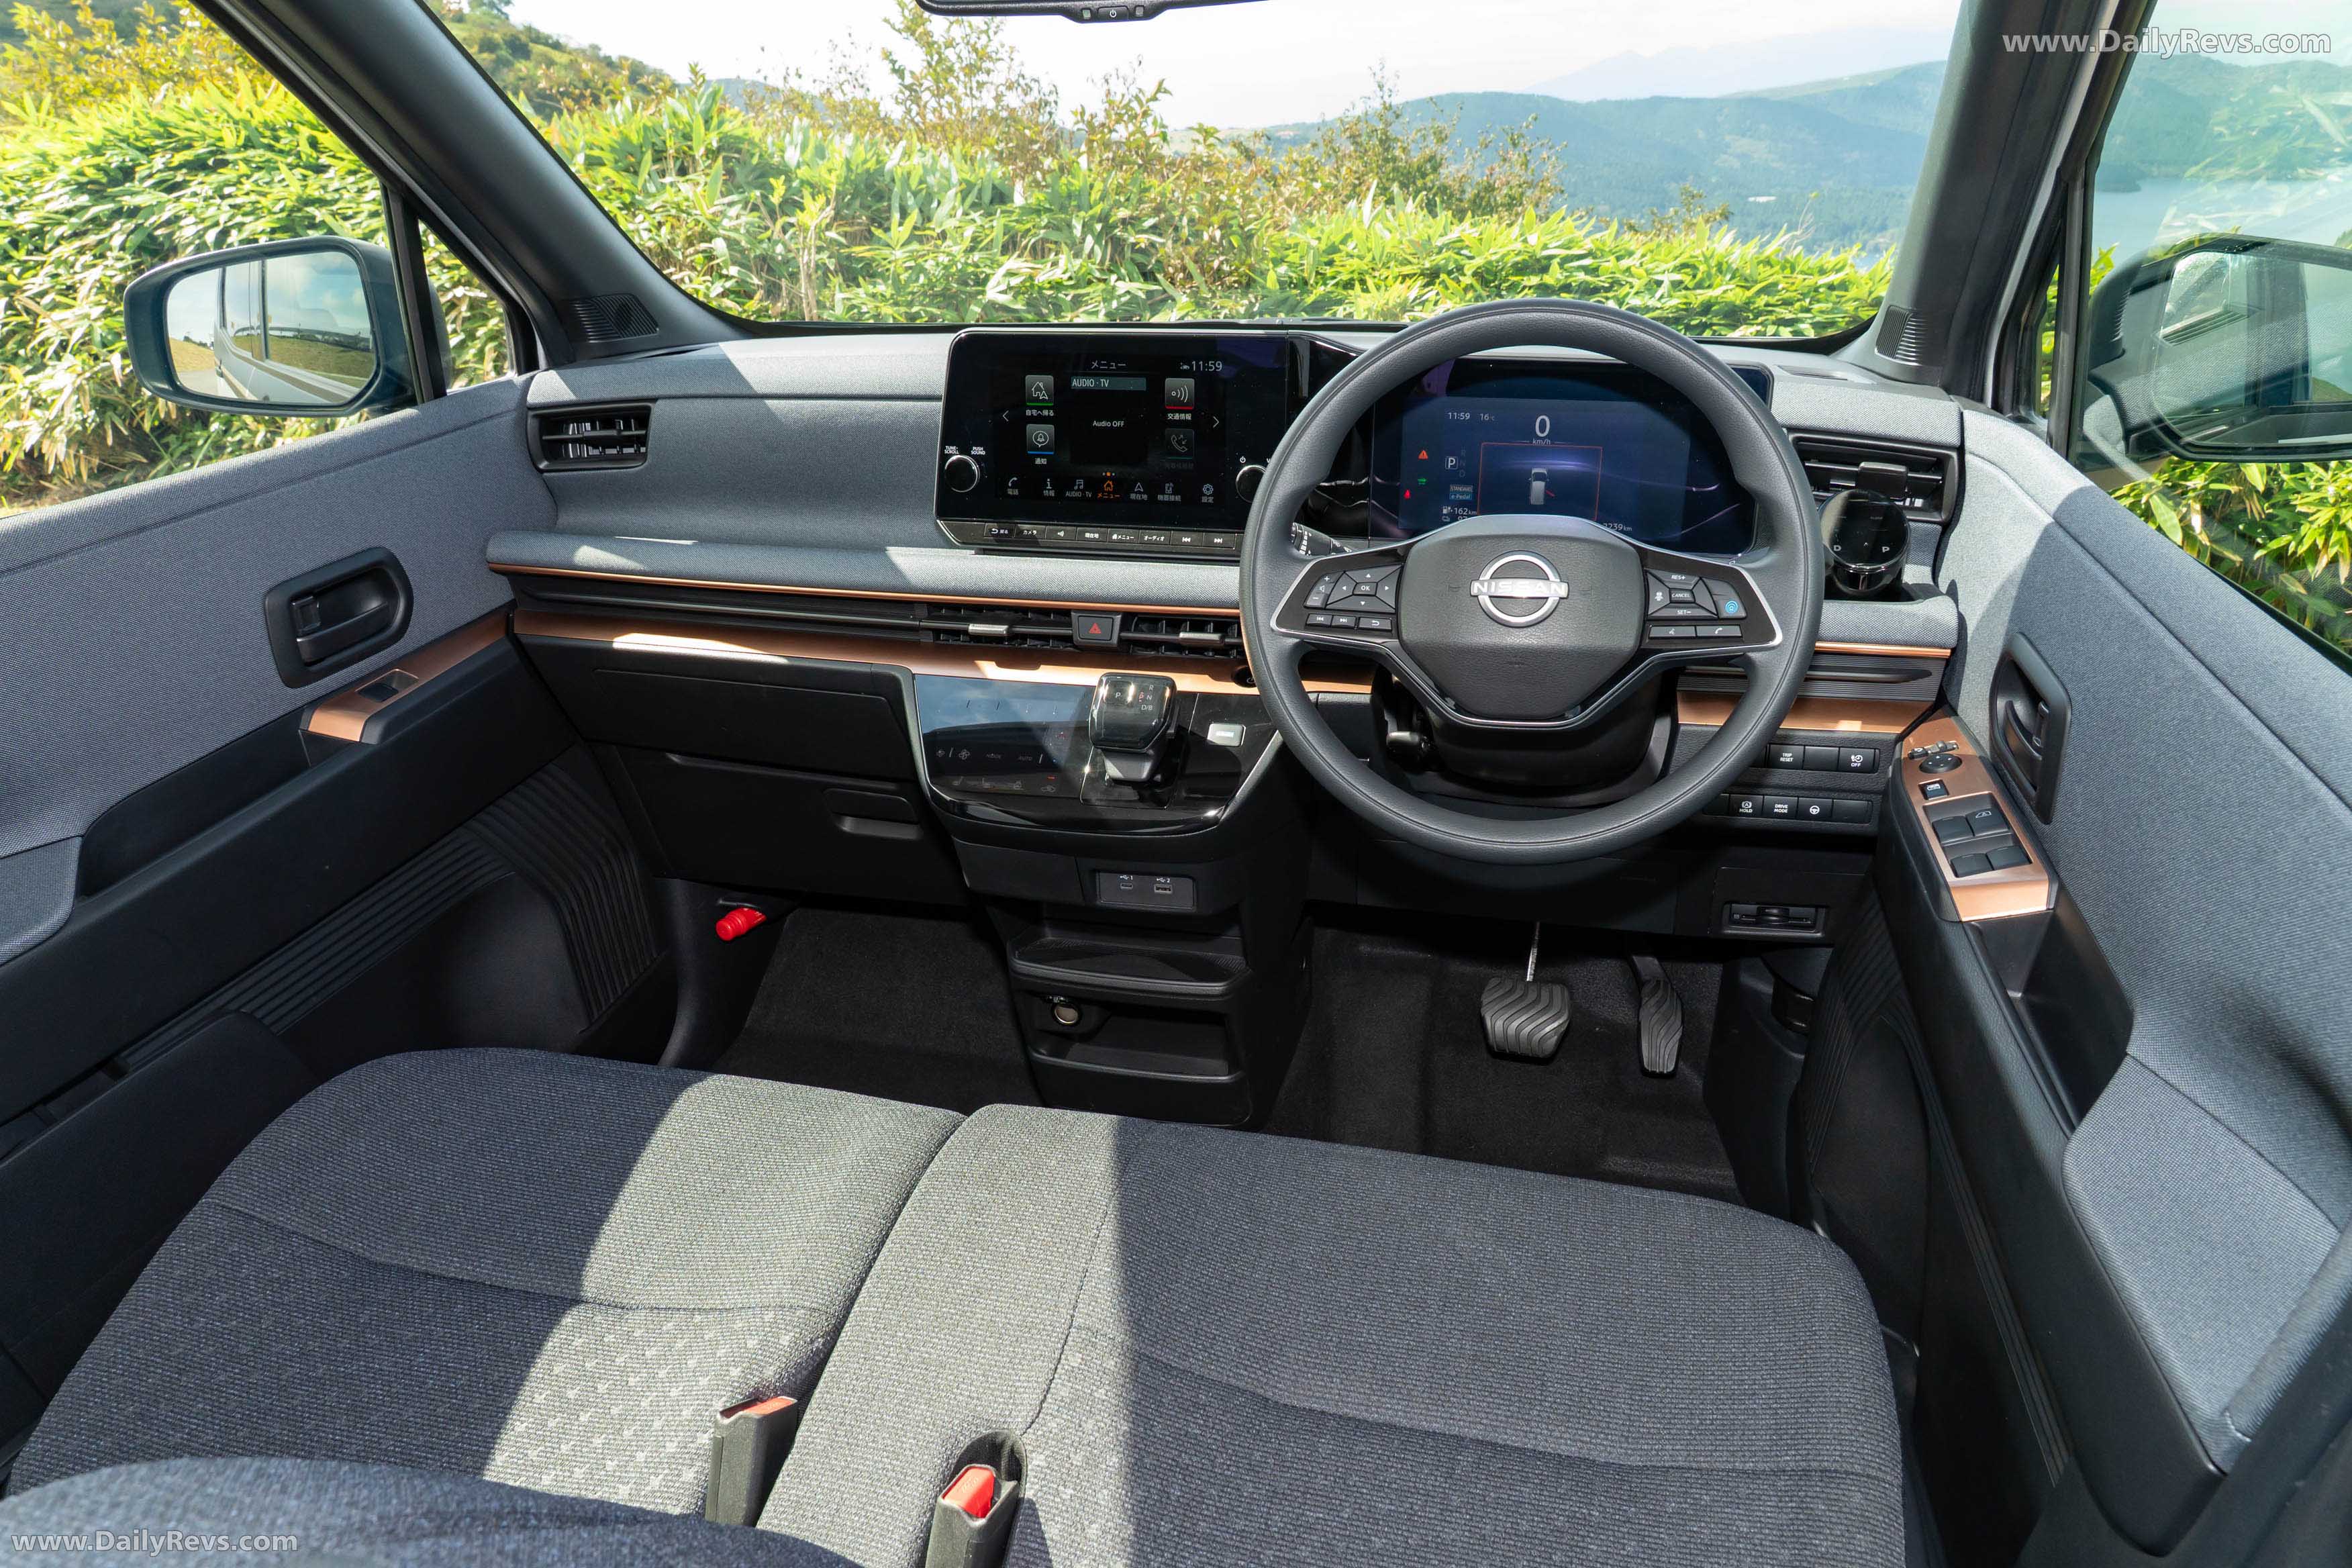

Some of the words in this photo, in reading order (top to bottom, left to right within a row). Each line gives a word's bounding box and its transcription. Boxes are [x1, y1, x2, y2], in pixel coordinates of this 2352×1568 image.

[1091, 360, 1126, 369] メニュー
[1191, 360, 1222, 371] 11:59
[1072, 379, 1095, 387] AUDIO
[1100, 379, 1110, 387] TV
[1534, 415, 1551, 437] 0
[1447, 457, 1456, 469] P
[1473, 580, 1565, 596] NISSAN
